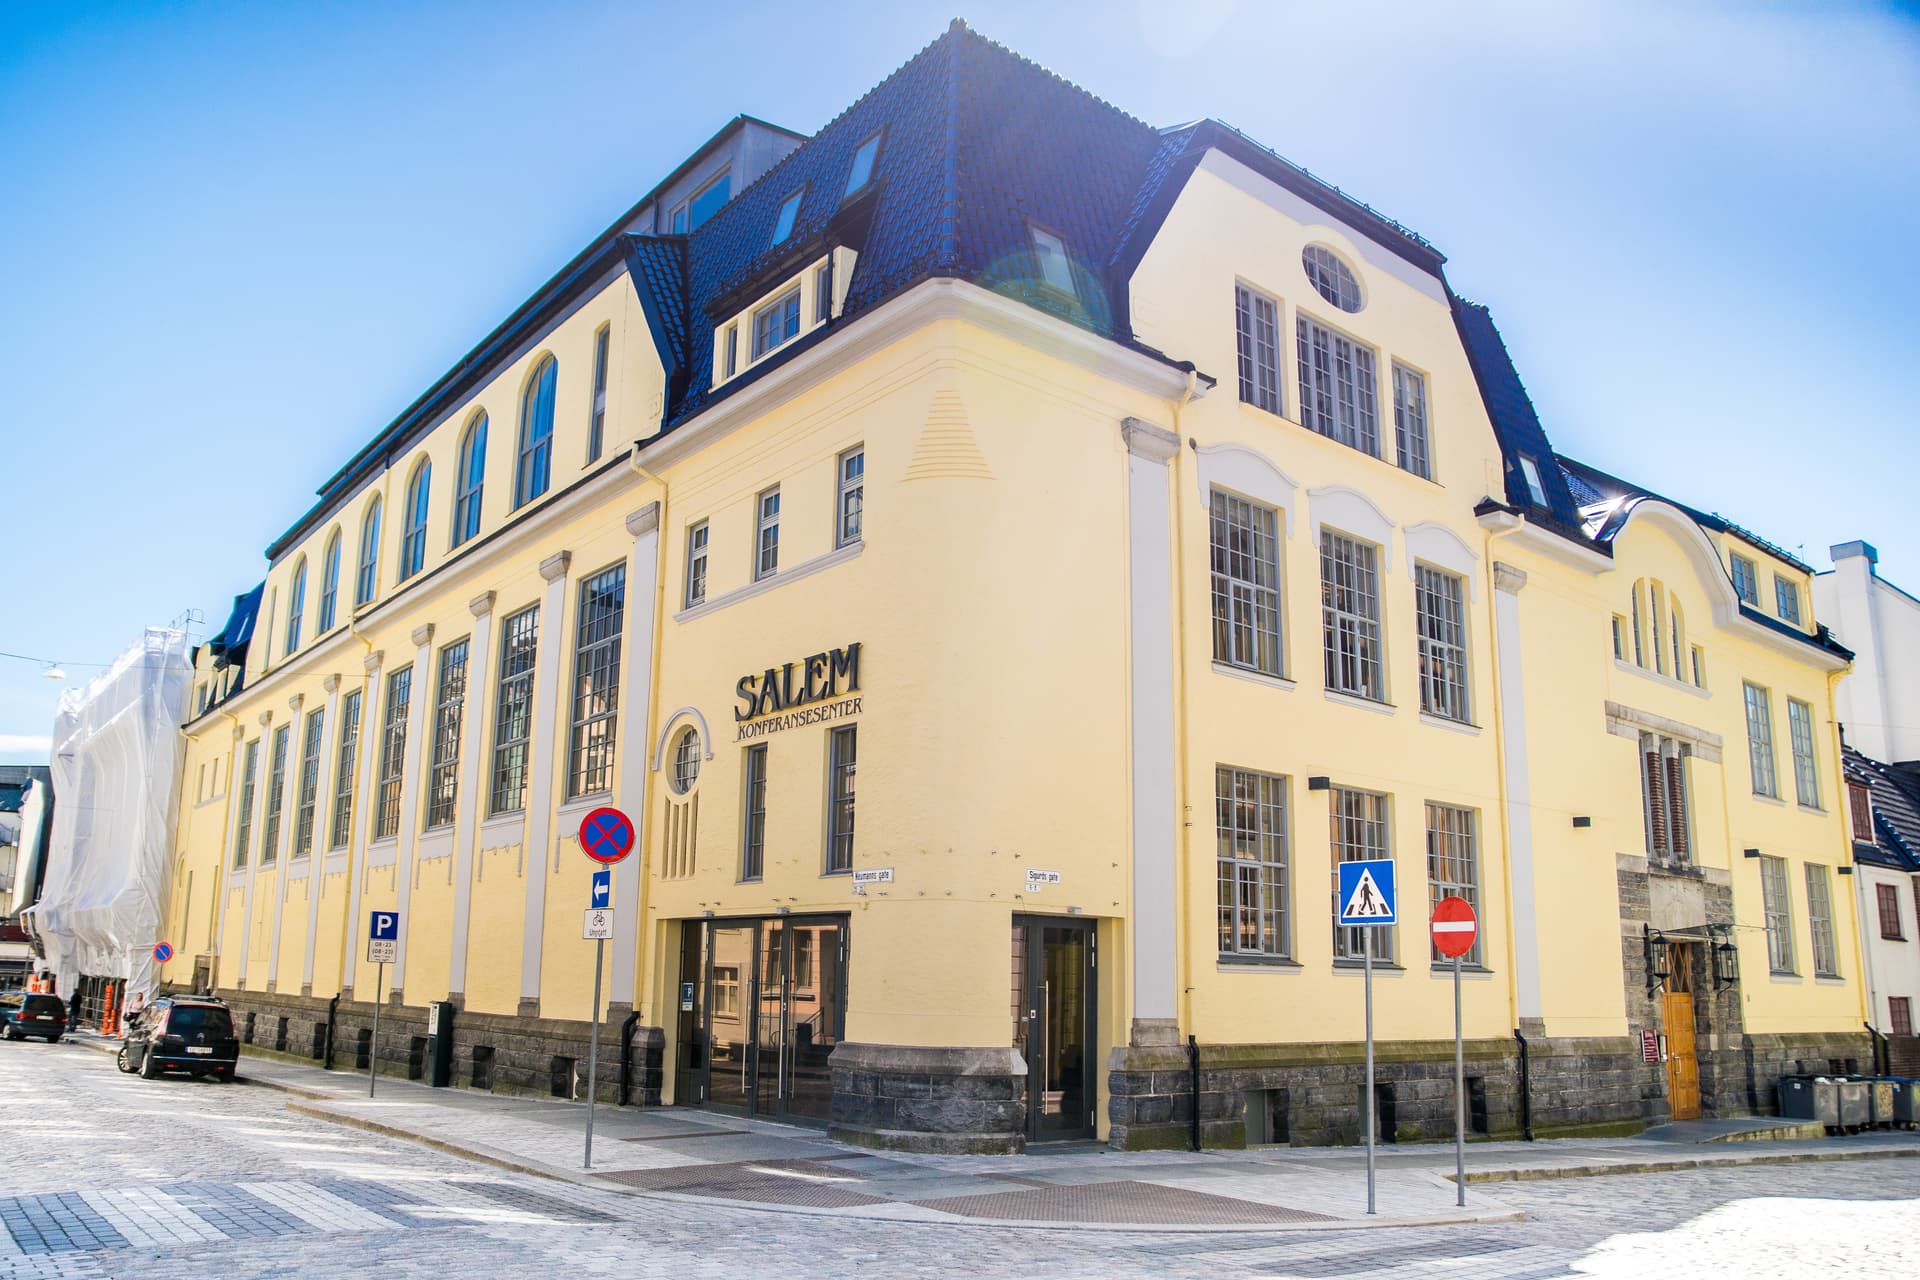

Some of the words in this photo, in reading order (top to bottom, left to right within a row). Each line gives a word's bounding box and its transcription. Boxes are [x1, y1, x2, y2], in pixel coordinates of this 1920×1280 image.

[734, 642, 862, 722] SALEM
[736, 697, 863, 741] KONFERANSESENTER
[376, 914, 393, 936] P
